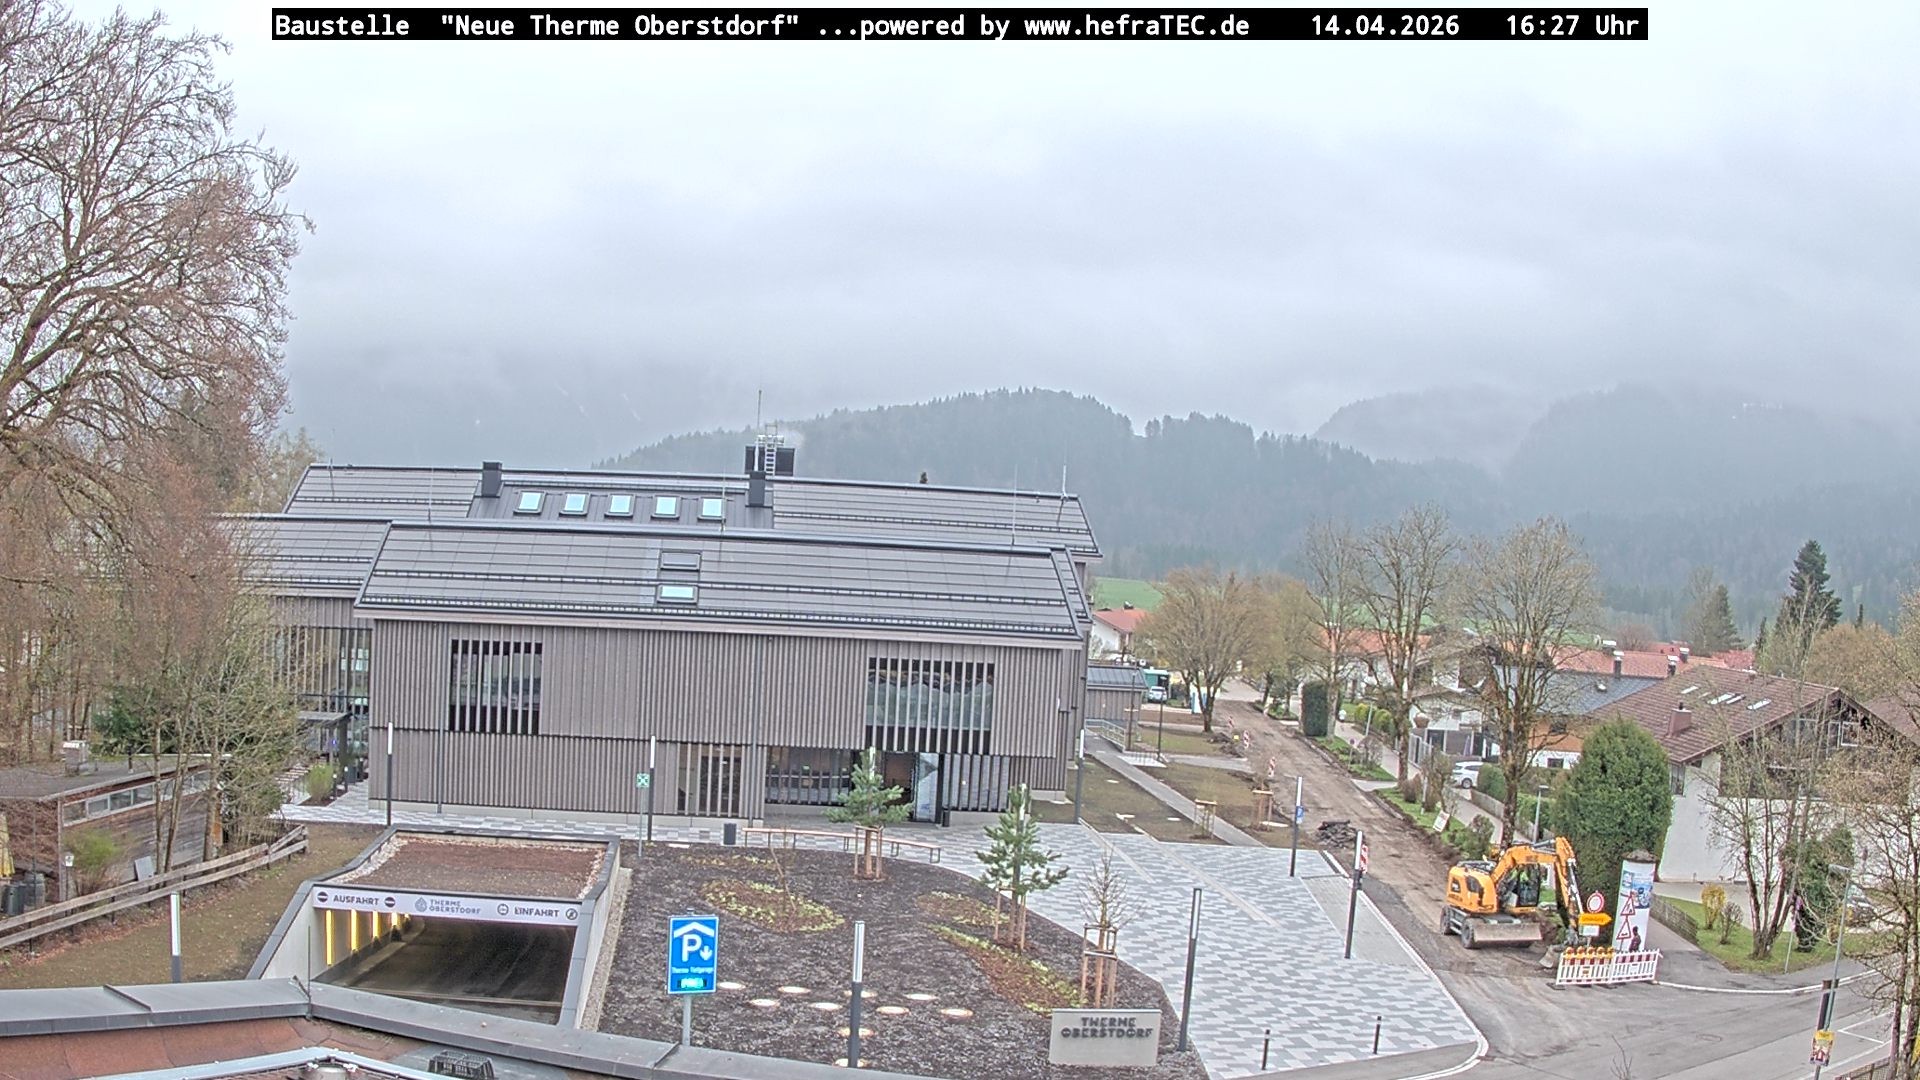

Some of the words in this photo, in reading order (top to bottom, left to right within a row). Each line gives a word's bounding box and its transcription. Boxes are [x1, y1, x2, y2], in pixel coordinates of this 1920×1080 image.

[333, 895, 380, 906] AUSFAHRT
[514, 907, 560, 917] EINFAHRT
[682, 934, 702, 962] P
[1081, 1017, 1136, 1027] THERME
[1061, 1027, 1153, 1038] OBERSTDORF
